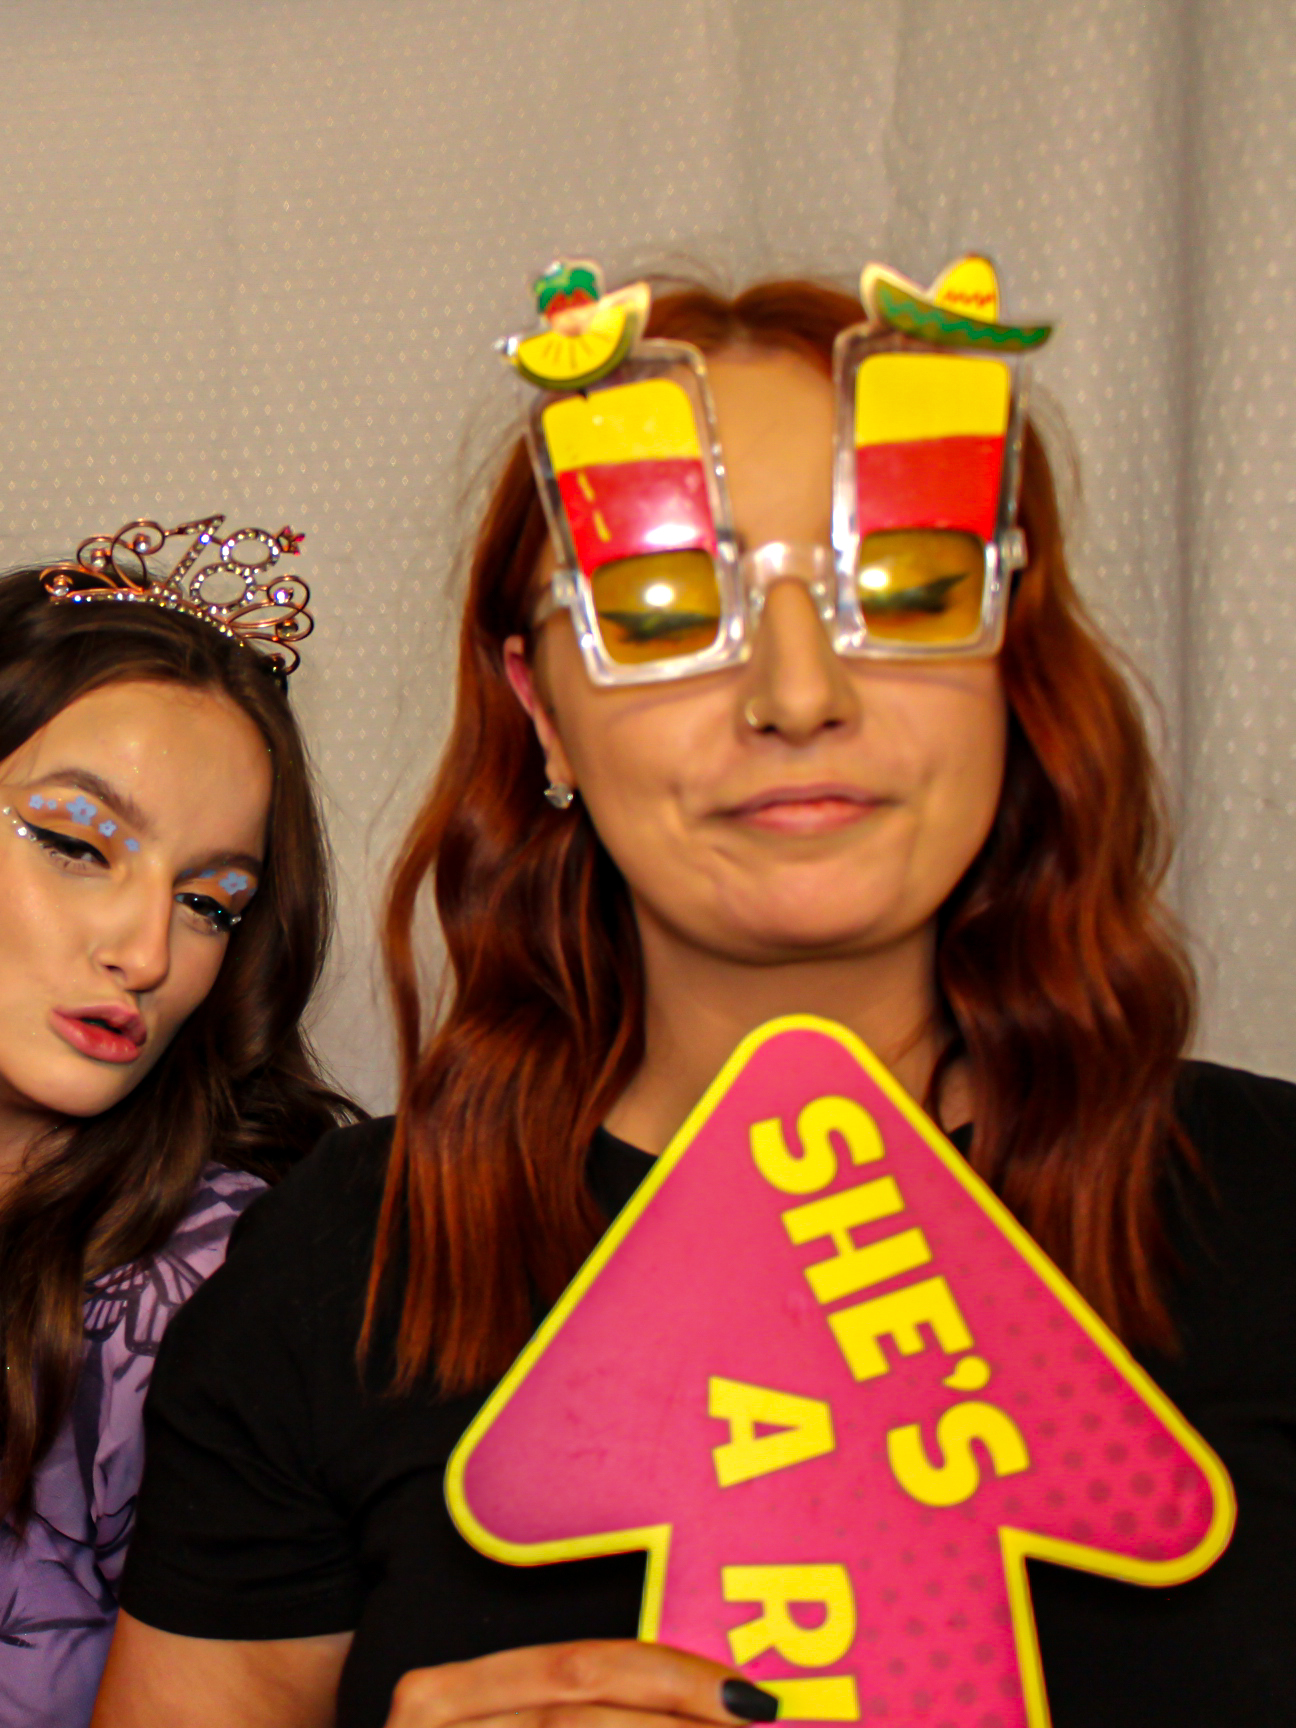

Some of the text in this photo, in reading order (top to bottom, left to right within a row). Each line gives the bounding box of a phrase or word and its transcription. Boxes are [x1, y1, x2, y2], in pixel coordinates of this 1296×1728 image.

[163, 514, 281, 615] 18
[749, 1095, 1031, 1507] SHE'S
[708, 1376, 836, 1487] A
